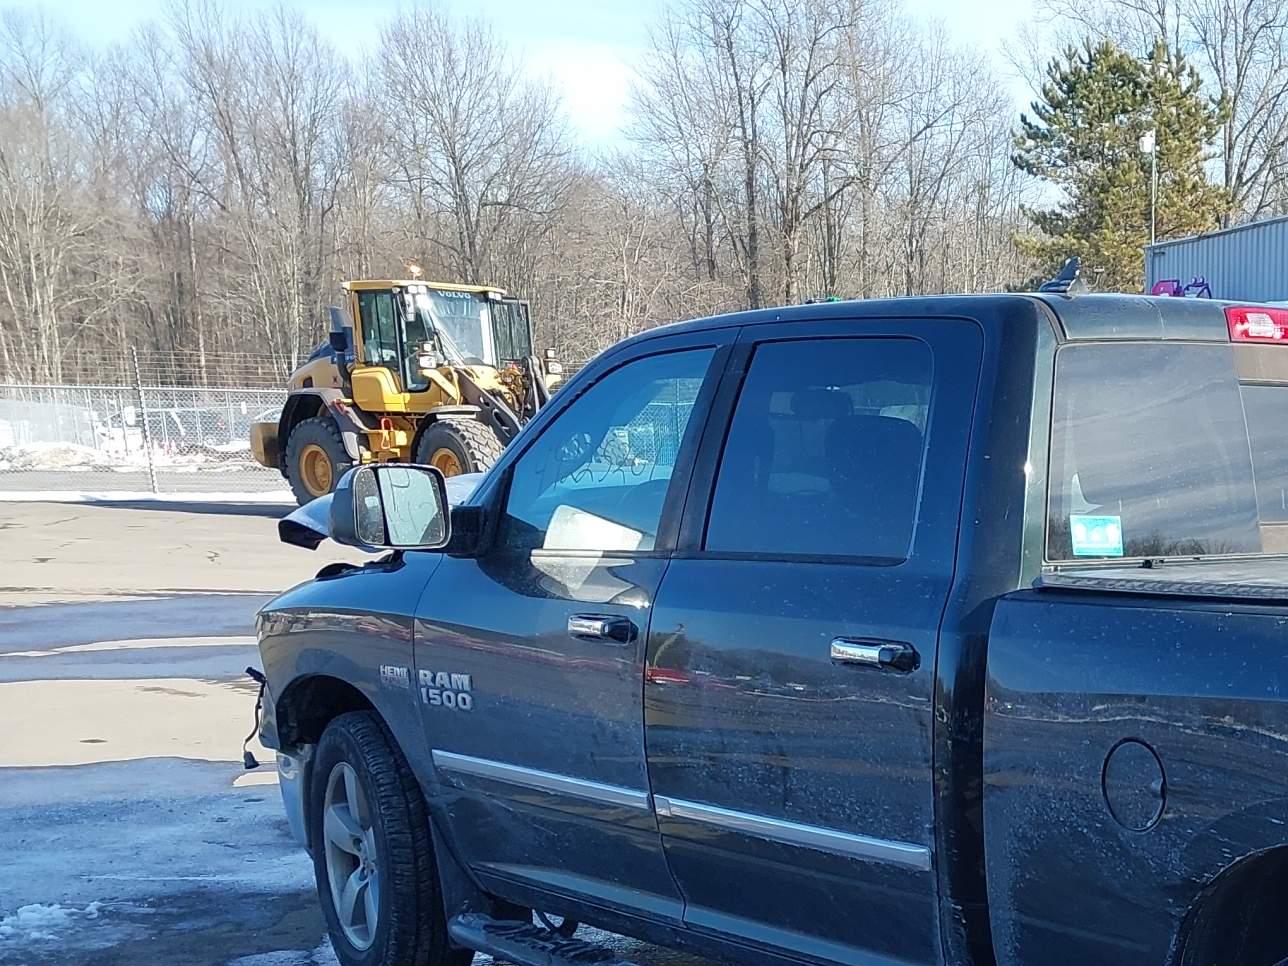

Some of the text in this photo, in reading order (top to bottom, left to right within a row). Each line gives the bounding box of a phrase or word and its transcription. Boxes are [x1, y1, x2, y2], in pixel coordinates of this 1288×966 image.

[437, 290, 471, 299] VOLVO
[379, 664, 408, 678] HEMI
[418, 669, 471, 691] RAM
[420, 687, 473, 710] 1500
